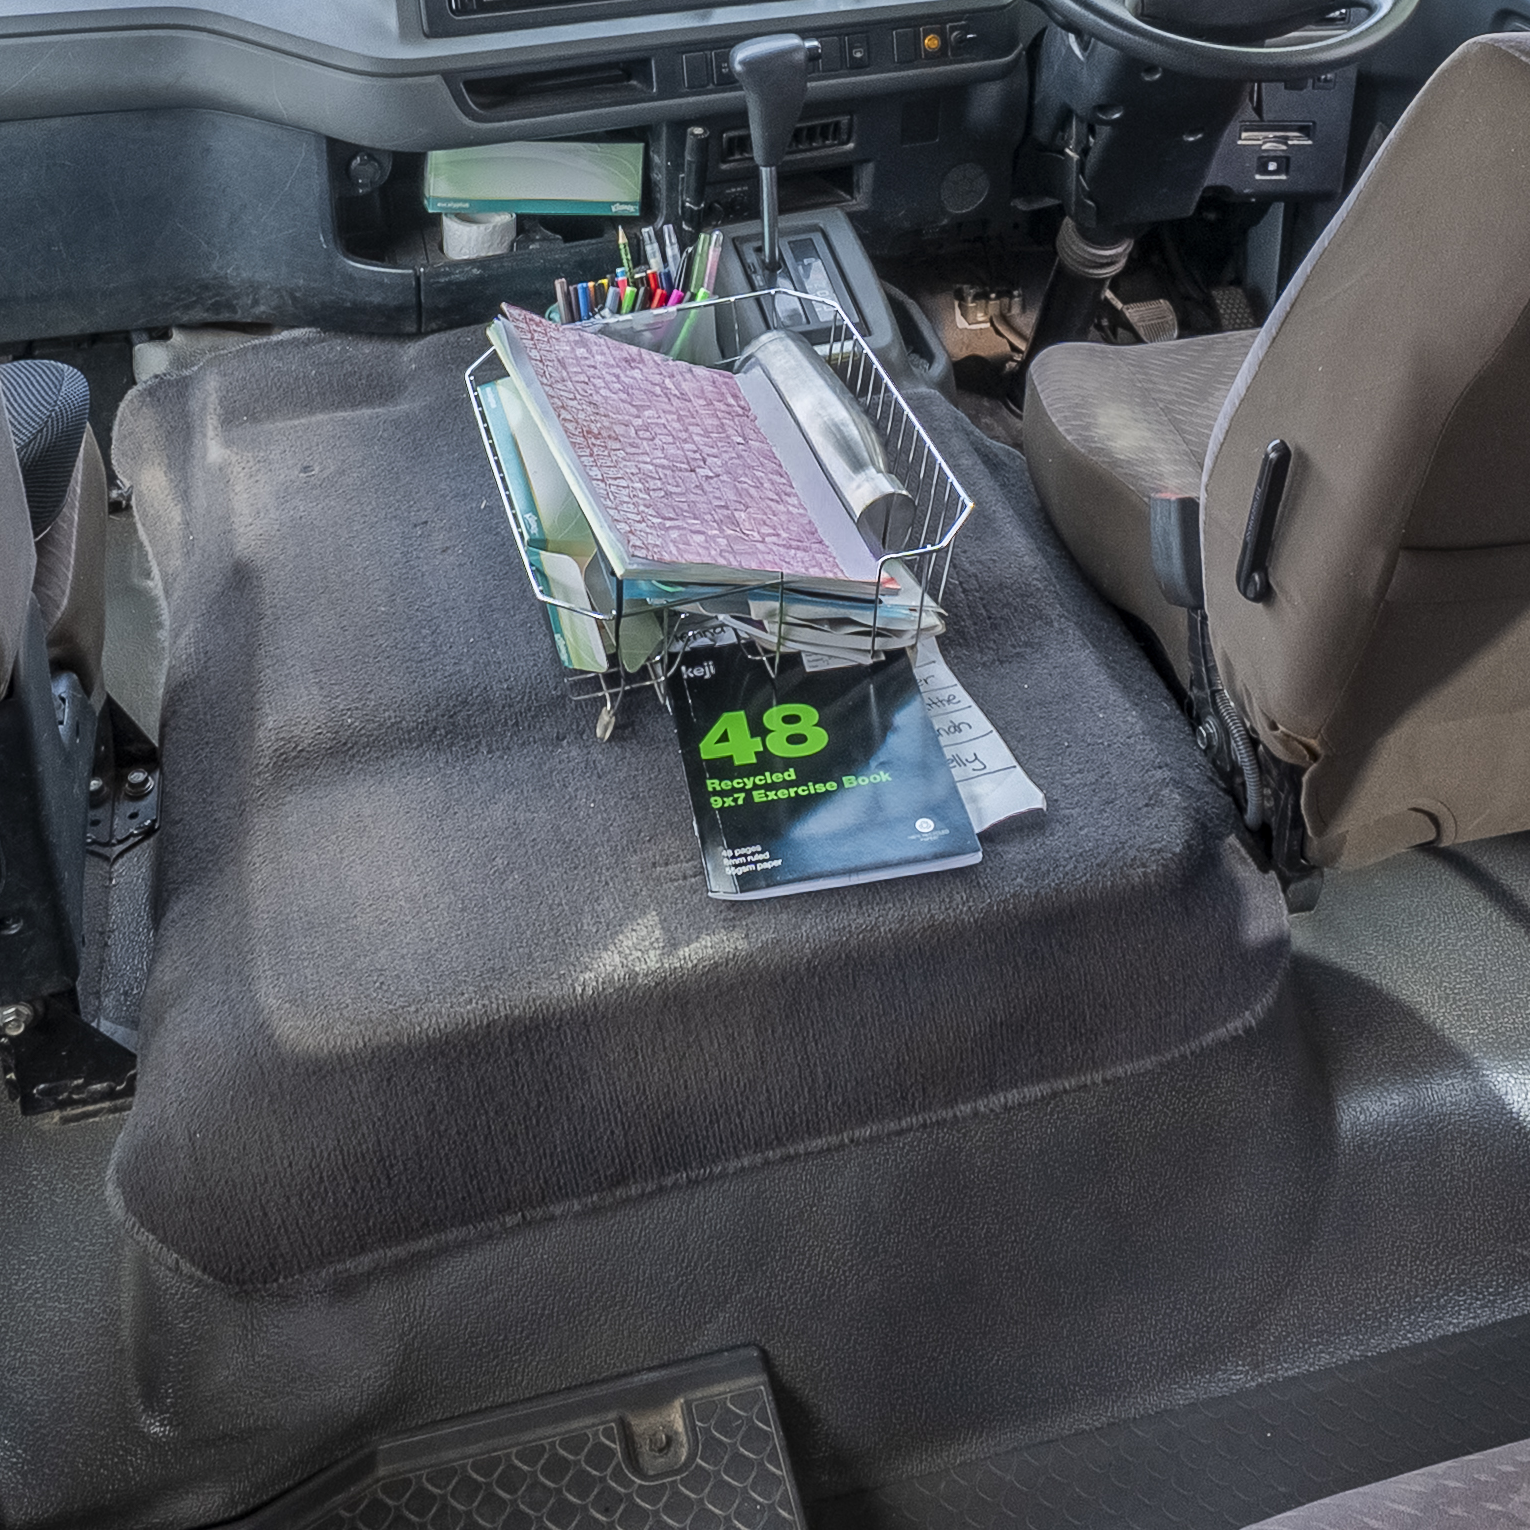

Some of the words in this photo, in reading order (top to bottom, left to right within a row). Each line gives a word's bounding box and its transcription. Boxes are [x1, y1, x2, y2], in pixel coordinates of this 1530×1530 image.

[681, 661, 716, 680] keji
[699, 703, 829, 766] 48
[706, 768, 796, 791] Recycled
[710, 792, 746, 809] 9x7
[752, 781, 838, 803] Exercise
[842, 771, 892, 789] Book
[734, 844, 762, 857] pages
[747, 851, 770, 862] ruled
[756, 859, 783, 872] paper
